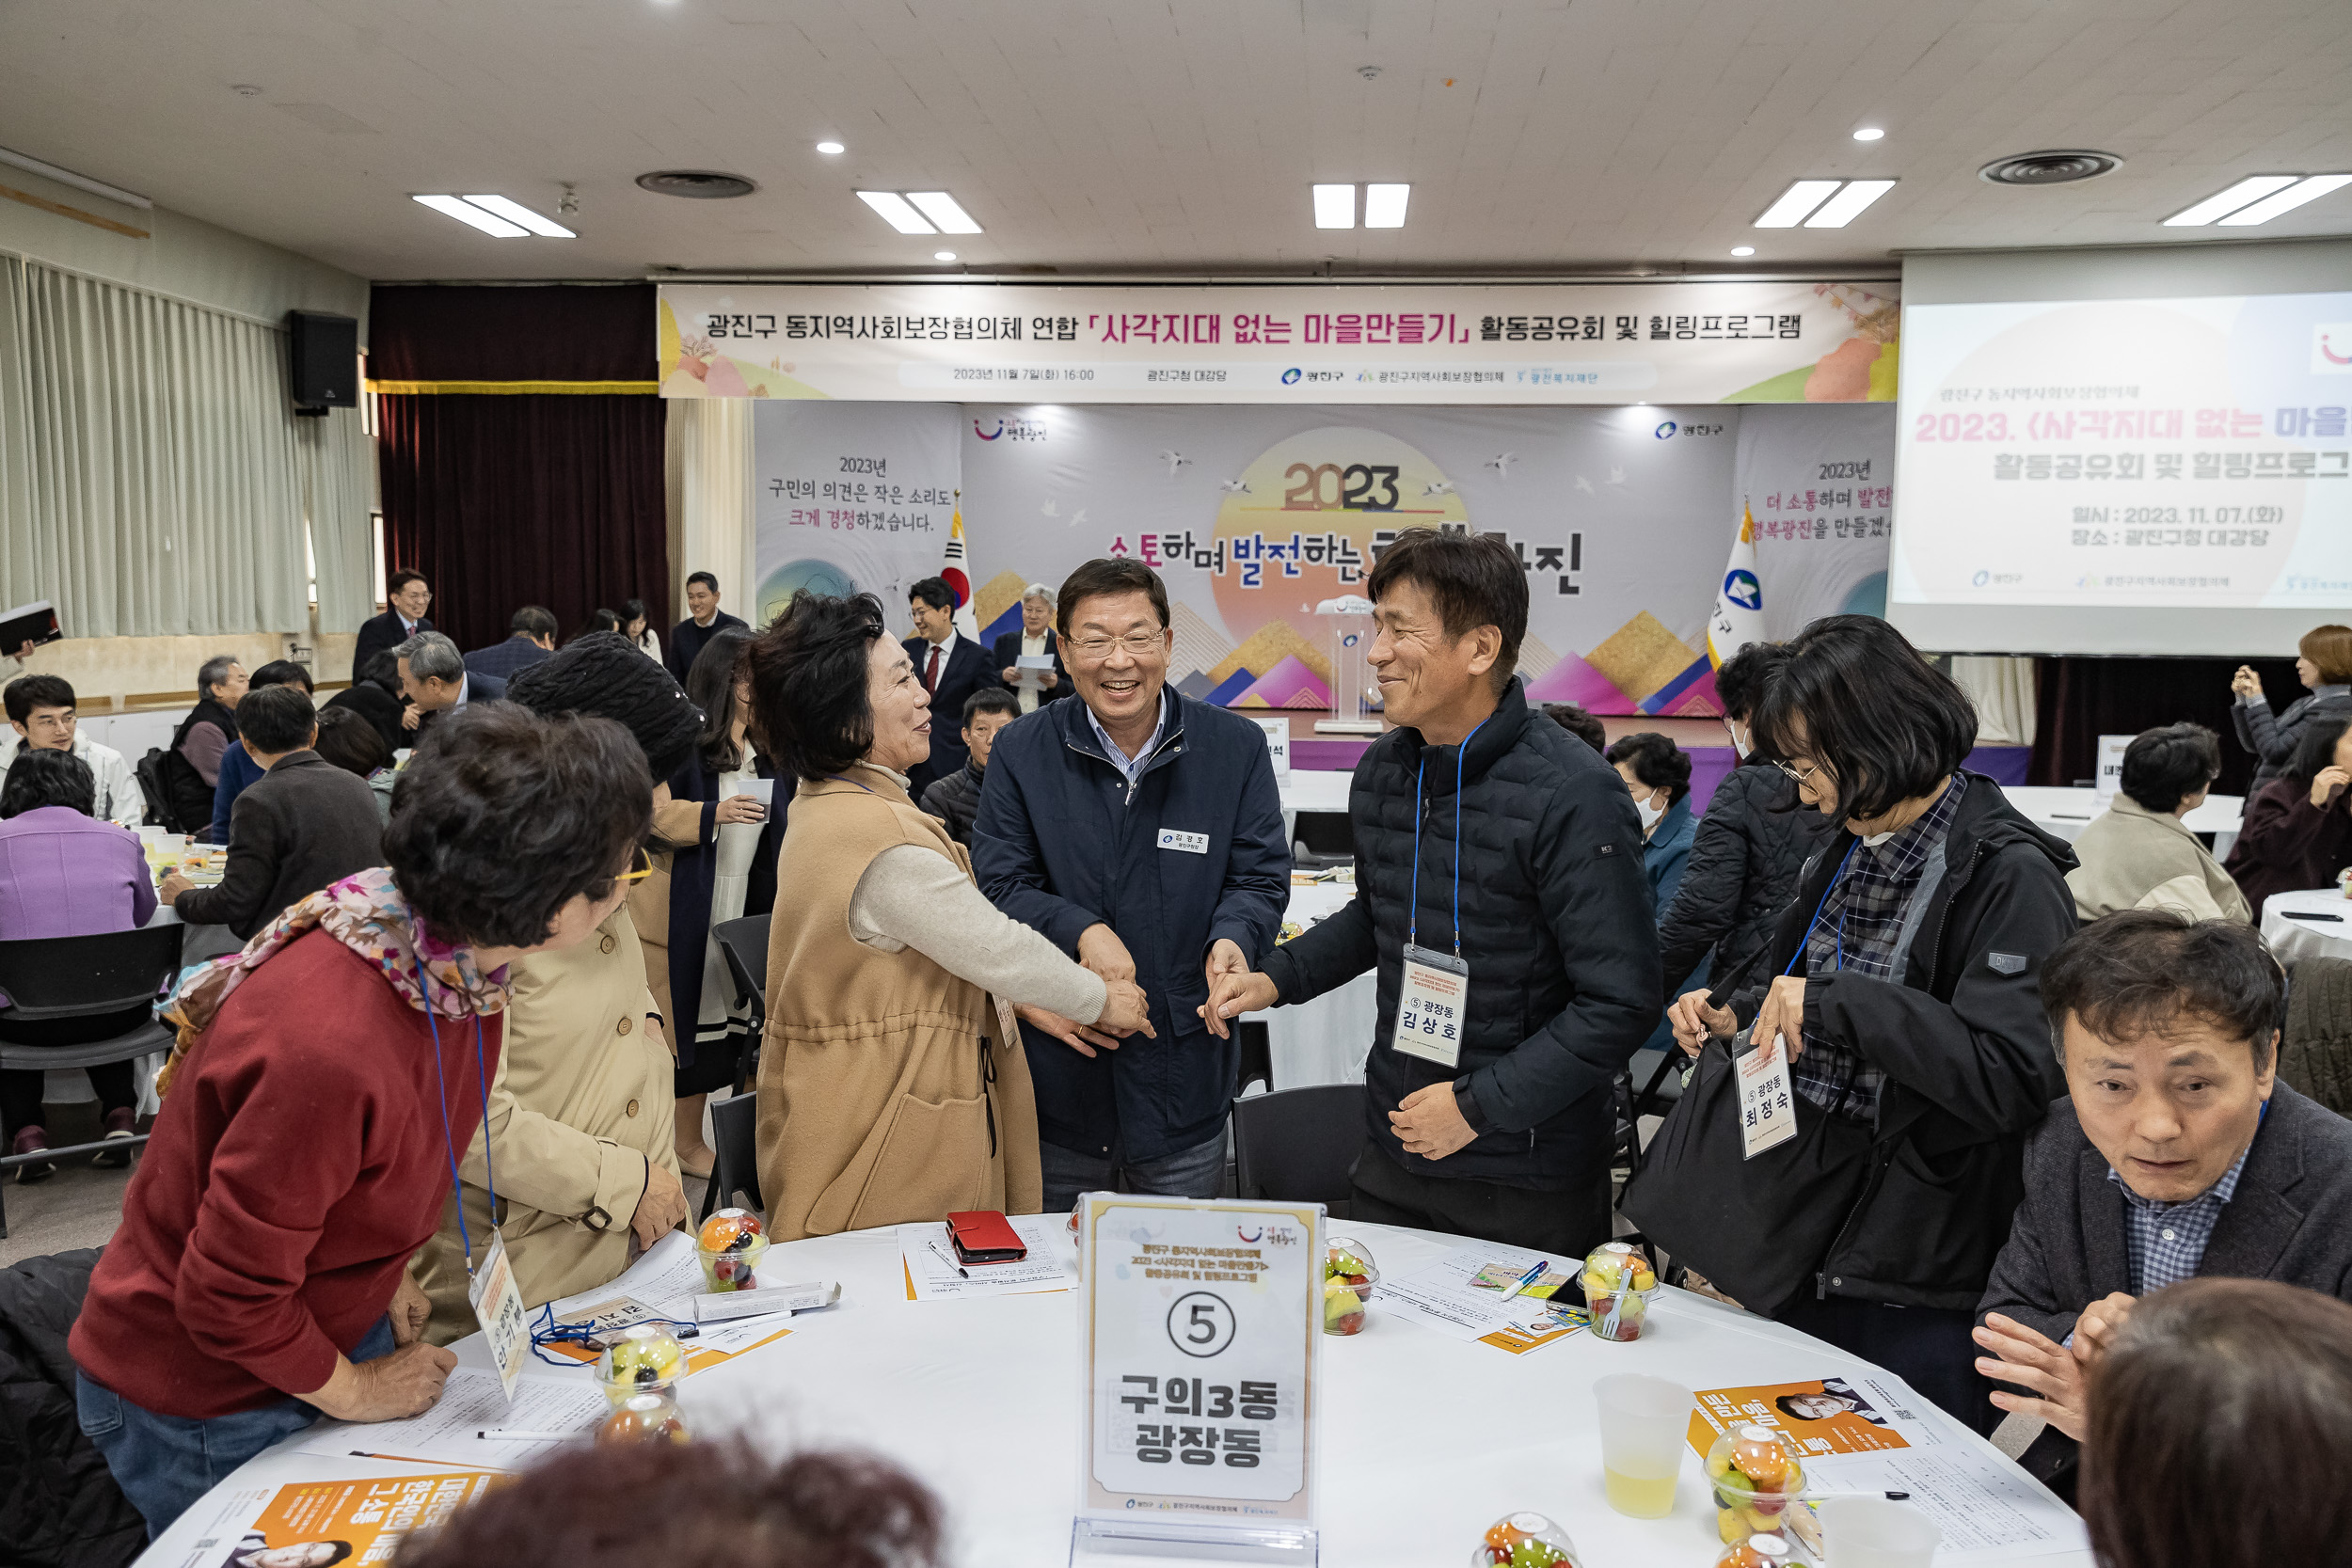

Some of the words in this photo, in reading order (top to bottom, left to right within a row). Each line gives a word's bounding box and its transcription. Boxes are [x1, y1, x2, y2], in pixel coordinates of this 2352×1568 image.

[707, 314, 777, 340] 광진구
[787, 314, 1023, 341] 동지역사회보장협의체
[1032, 315, 1079, 342] 연합
[1233, 313, 1292, 345] 없는
[1479, 315, 1606, 342] 활동공유회
[1615, 314, 1639, 341] 및
[1649, 314, 1803, 341] 힐링프로그램
[953, 369, 993, 381] 2023년
[997, 369, 1018, 381] 11월
[1022, 369, 1059, 381] 7일(화)
[1064, 369, 1094, 380] 16:00
[1147, 370, 1190, 382] 광진구청
[1194, 370, 1227, 382] 대강당
[1915, 412, 2016, 442] 2023.
[2195, 407, 2263, 438] 없는
[839, 456, 886, 478] 2023년
[1819, 459, 1871, 482] 2023년
[1994, 452, 2144, 481] 활동공유회
[2153, 452, 2184, 480] 및
[769, 479, 816, 499] 구민의
[823, 483, 868, 502] 의견은
[874, 484, 904, 505] 작은
[909, 487, 951, 507] 소리도
[1284, 463, 1399, 511] 2023
[1767, 493, 1781, 512] 더
[1787, 488, 1851, 512] 소통하며
[788, 509, 821, 529] 크게
[826, 509, 934, 532] 경청하겠습니다.
[2073, 507, 2108, 523] 일시
[2072, 530, 2108, 546] 장소
[2124, 529, 2201, 546] 광진구청
[2208, 529, 2269, 546] 대강당
[1233, 533, 1362, 586] 발전하는
[1424, 1000, 1454, 1019] 광장동
[1758, 1074, 1781, 1098] 광장동
[1121, 1375, 1278, 1420] 구의3동
[1702, 1393, 1742, 1418] 만든
[1136, 1424, 1261, 1468] 광장동
[368, 1482, 401, 1497] 그
[350, 1498, 389, 1525] 소통
